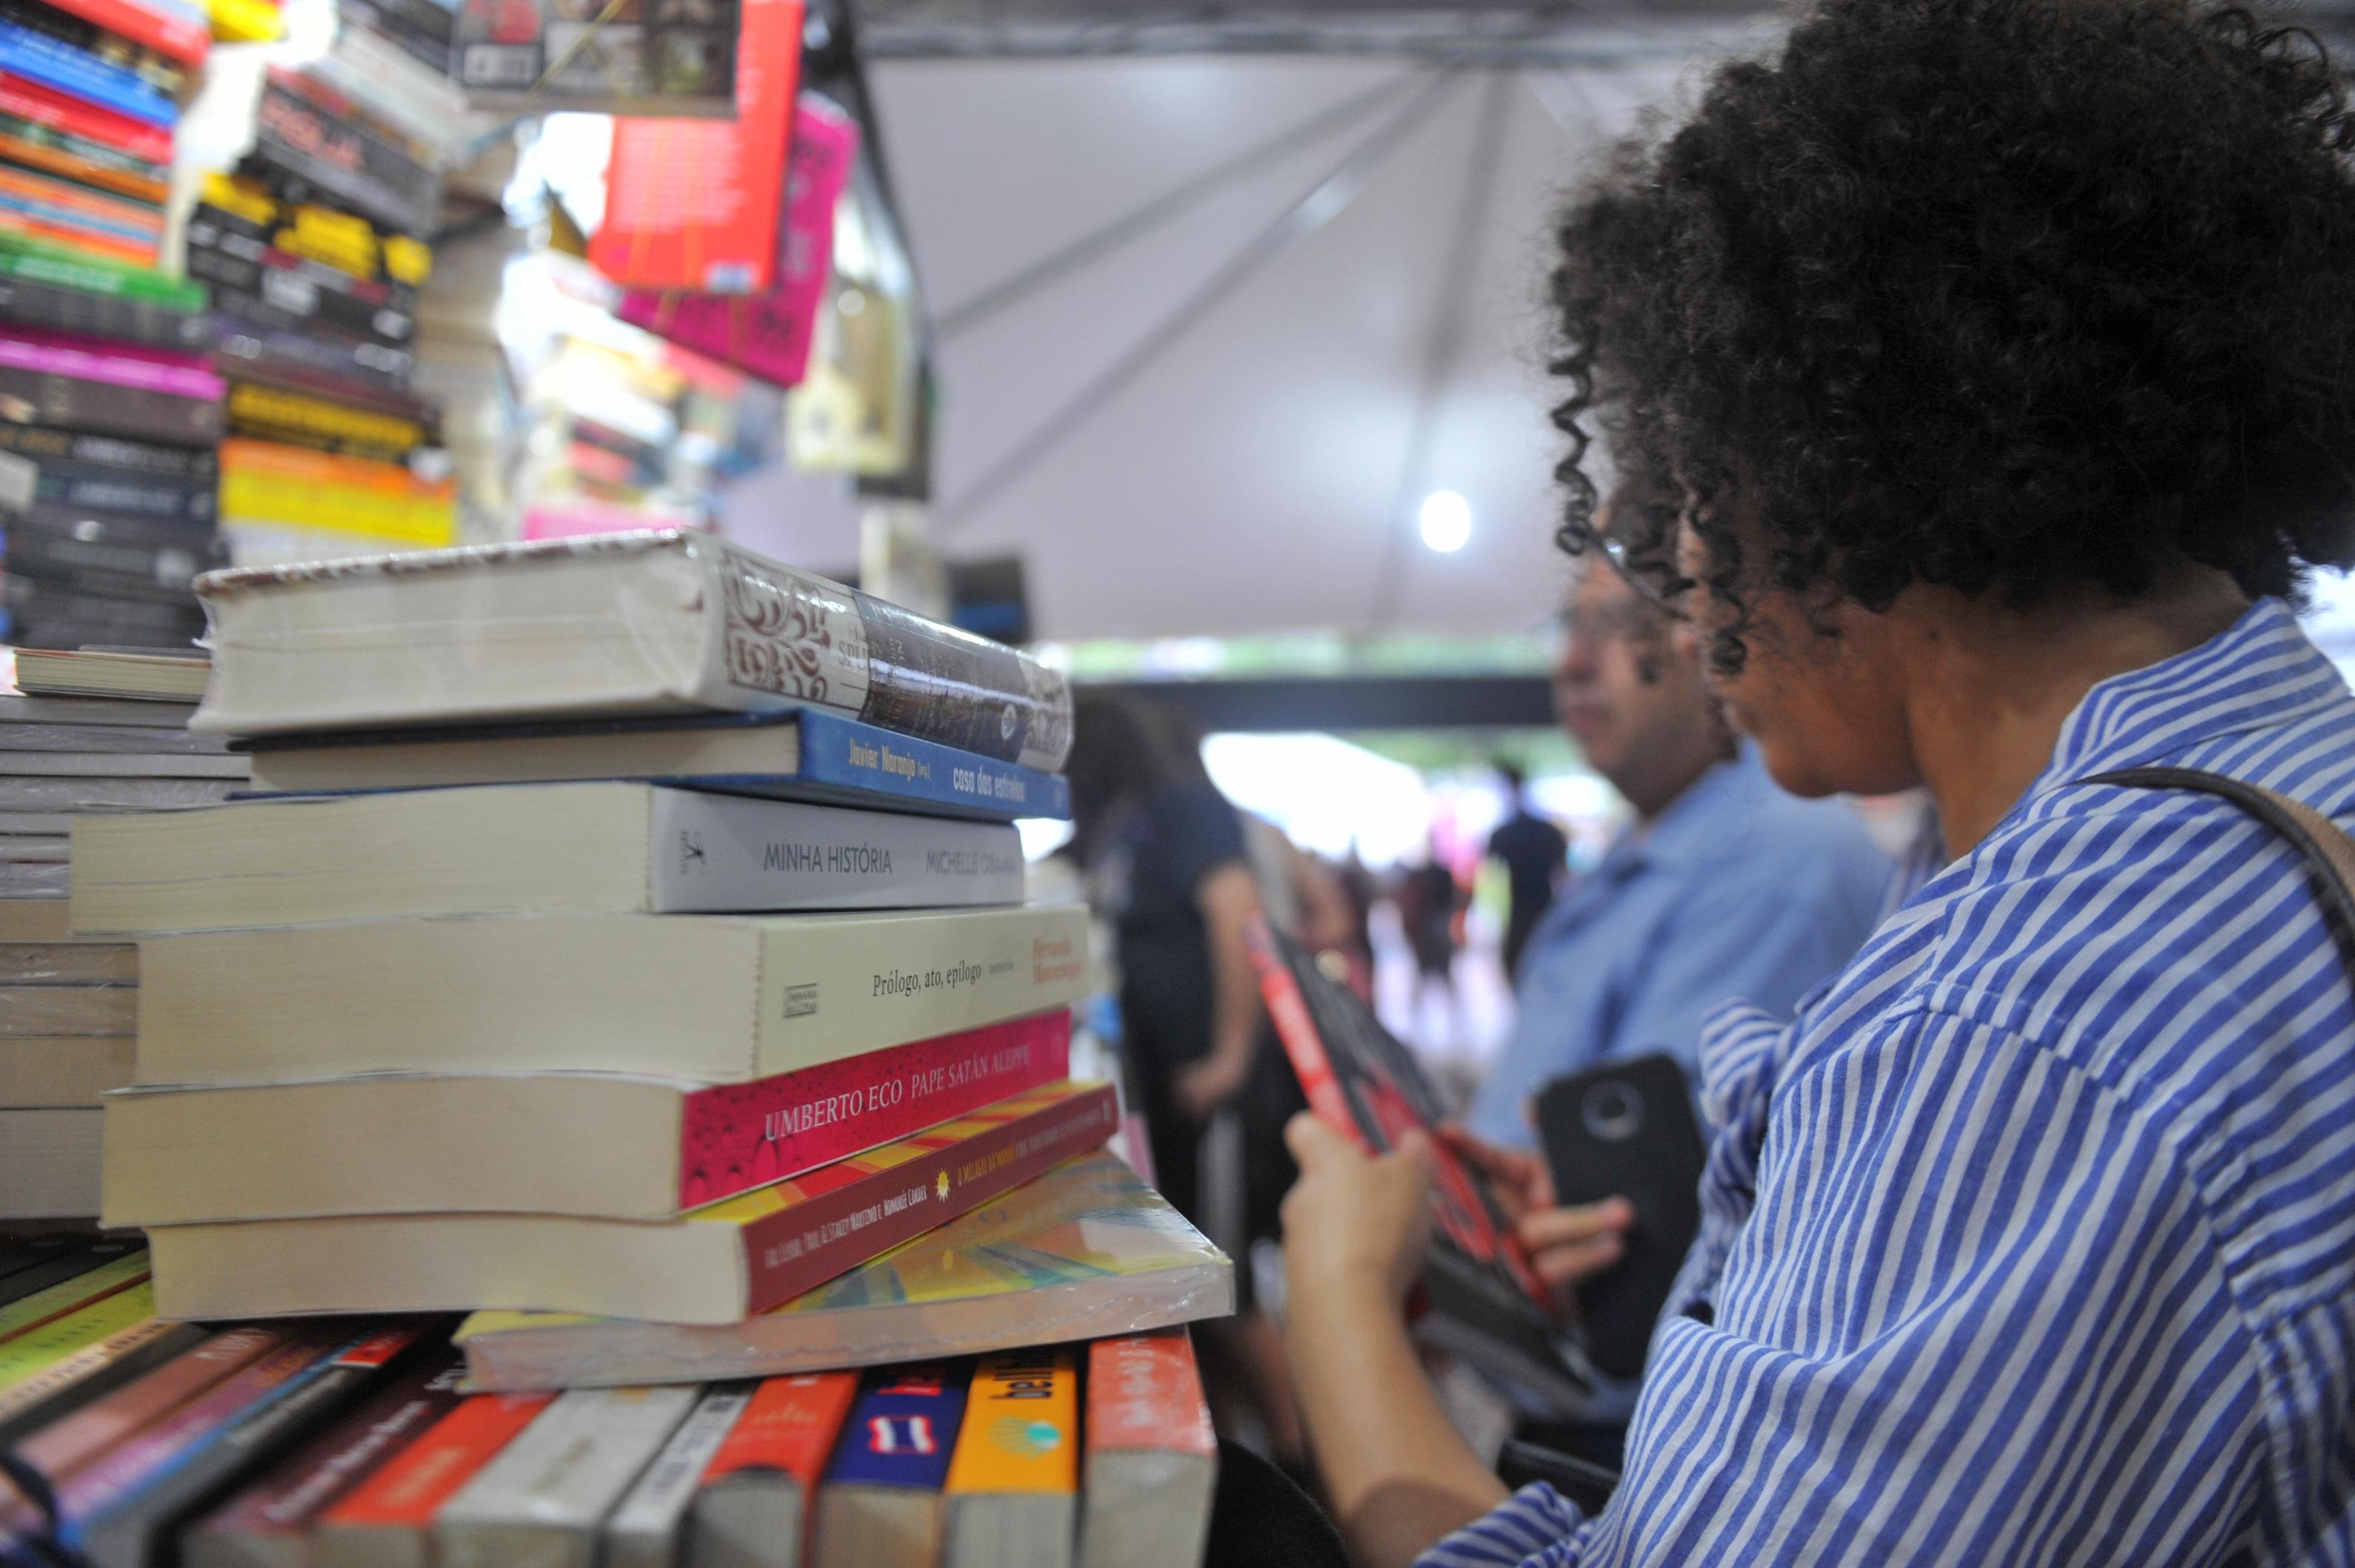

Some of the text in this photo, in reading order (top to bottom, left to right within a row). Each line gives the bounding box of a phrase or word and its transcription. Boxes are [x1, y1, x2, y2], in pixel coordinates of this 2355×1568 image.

[848, 737, 878, 770] Javier
[882, 744, 916, 782] Naranjo
[953, 767, 974, 794] casa
[977, 764, 993, 797] das
[764, 841, 893, 874] MINHA HISTÓRIA
[925, 850, 979, 875] MICHELLE
[872, 969, 922, 998] Prólogo,
[925, 968, 944, 990] ato,
[946, 959, 981, 989] epílogo
[910, 1067, 945, 1099] PAPE
[766, 1079, 903, 1141] UMBERTO ECO
